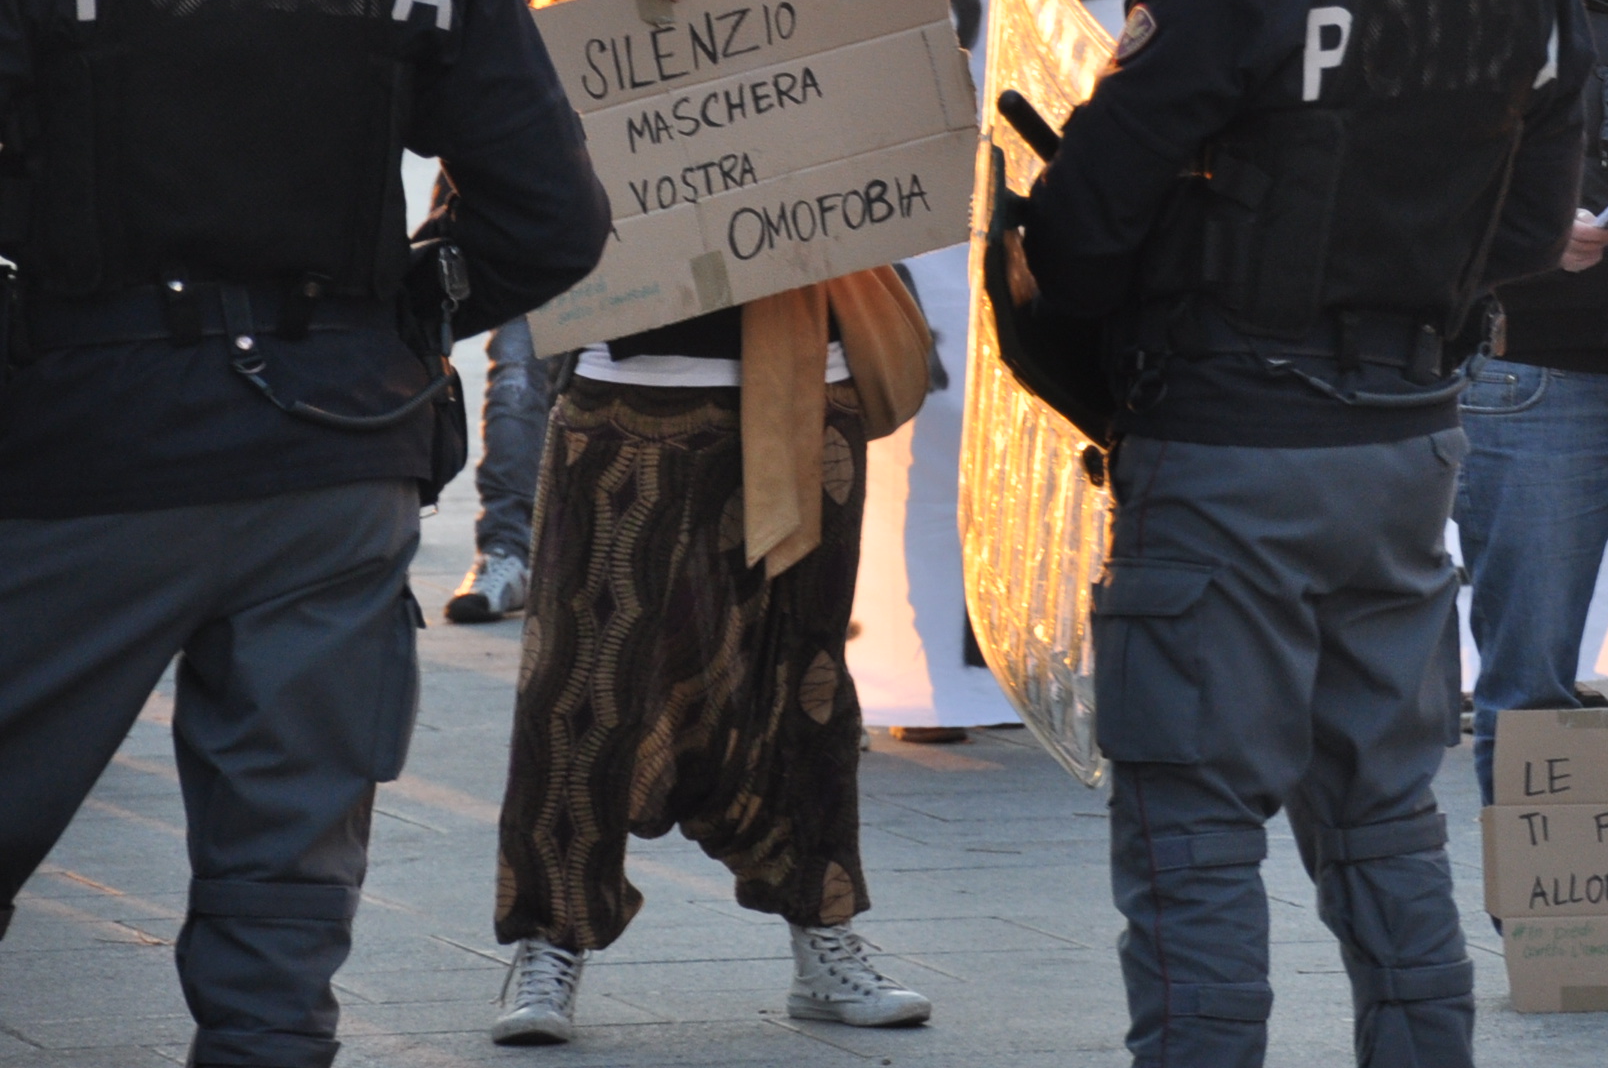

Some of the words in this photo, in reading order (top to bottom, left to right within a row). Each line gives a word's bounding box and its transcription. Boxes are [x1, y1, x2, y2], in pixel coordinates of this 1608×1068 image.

[581, 1, 796, 100] SILENZIO
[627, 66, 823, 153] MASCHERA
[628, 153, 758, 214] VOSTRA
[727, 174, 932, 260] OMOFOBIA
[1524, 758, 1572, 797] LE
[1519, 813, 1549, 845] TI
